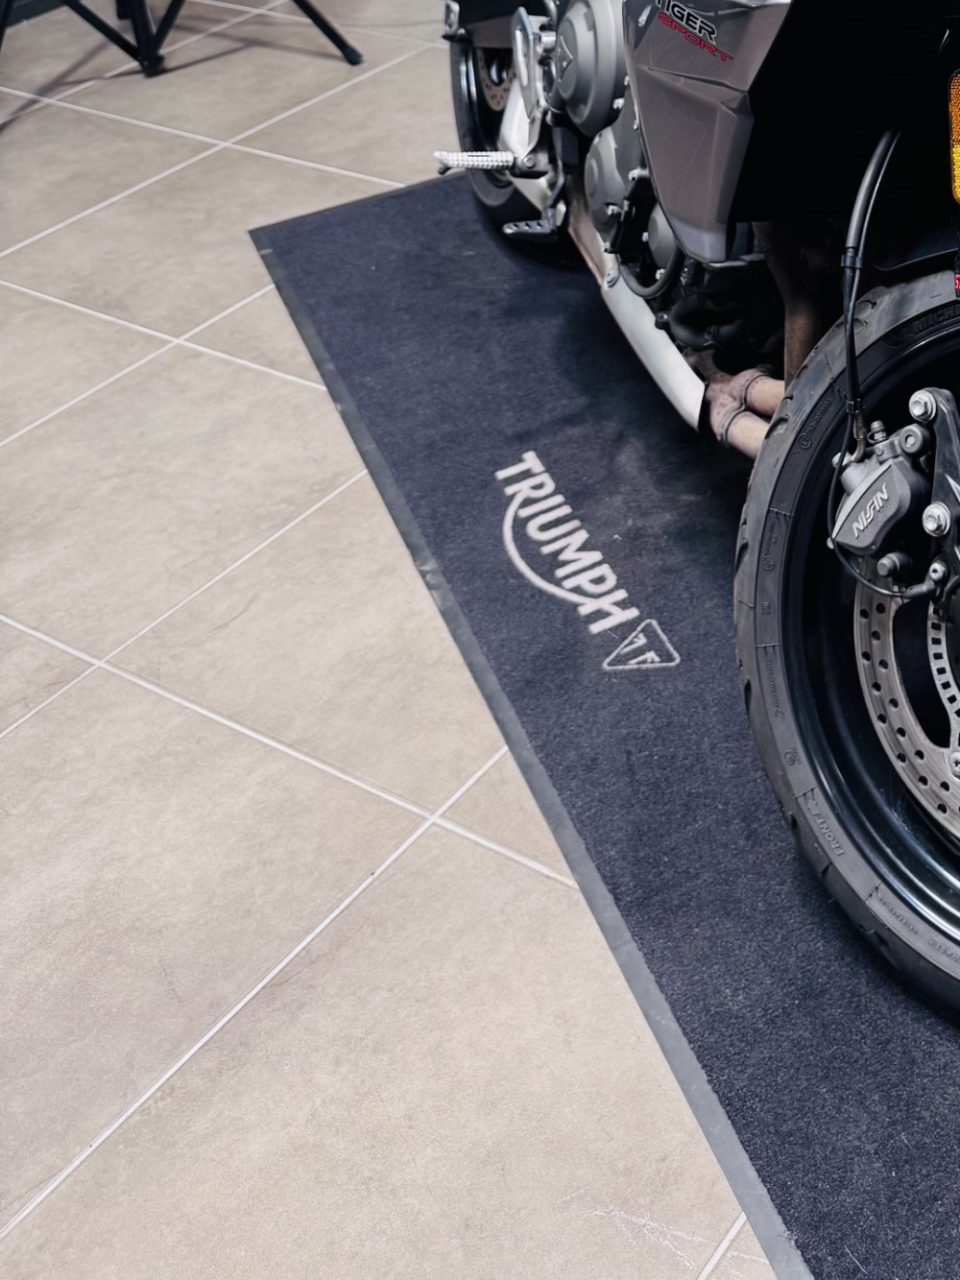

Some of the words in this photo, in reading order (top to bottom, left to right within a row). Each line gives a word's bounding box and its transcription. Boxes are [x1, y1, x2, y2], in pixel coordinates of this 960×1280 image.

[657, 11, 734, 62] SPORT
[494, 449, 641, 634] TRIUMPH
[815, 817, 845, 856] FRONT
